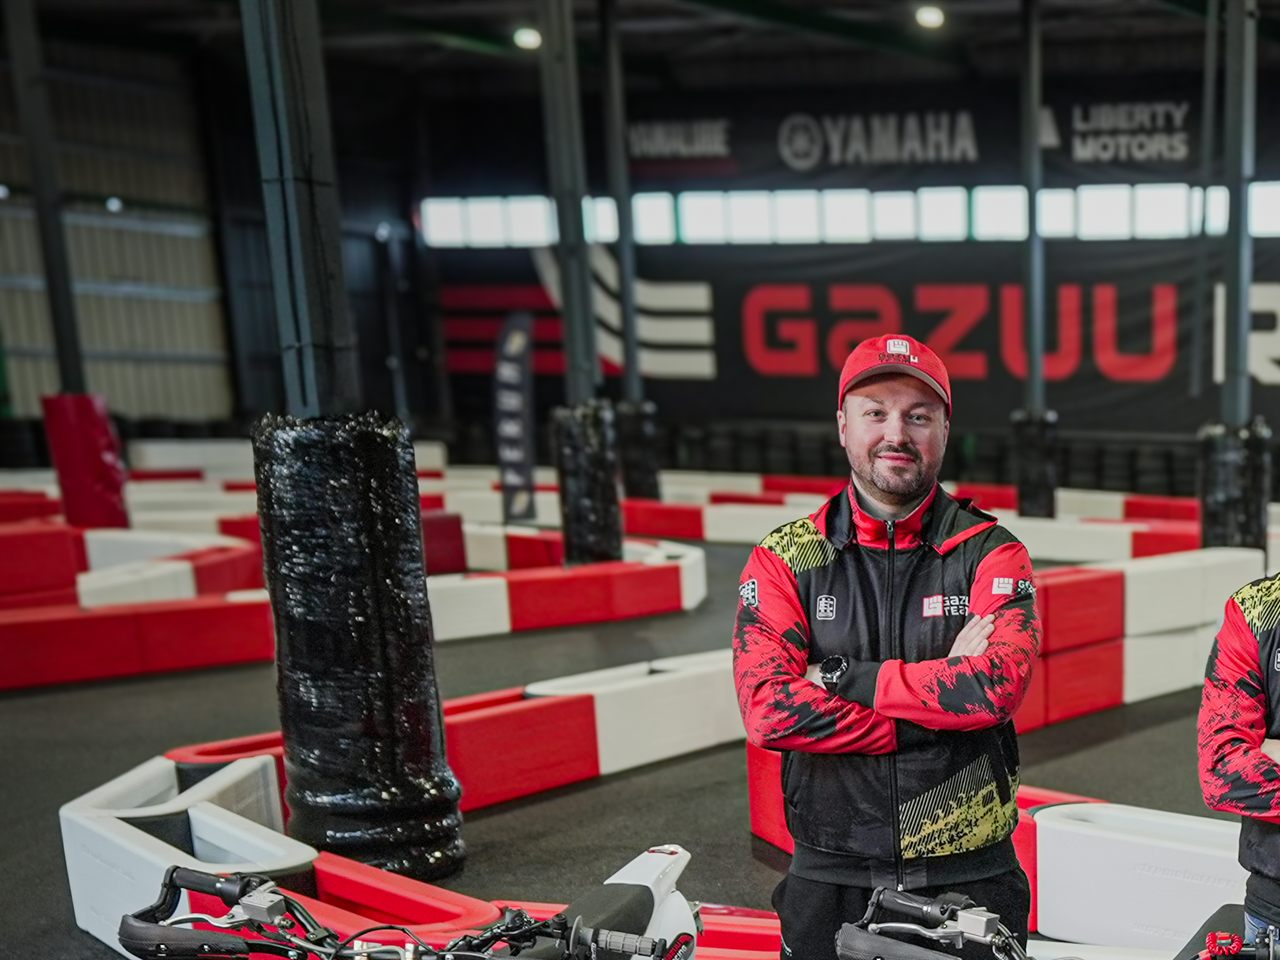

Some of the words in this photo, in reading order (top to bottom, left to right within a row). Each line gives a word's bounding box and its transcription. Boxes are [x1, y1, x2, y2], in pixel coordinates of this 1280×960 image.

[1072, 102, 1188, 130] LIBERTY
[822, 112, 977, 164] YAMAHA
[1072, 132, 1187, 161] MOTORS
